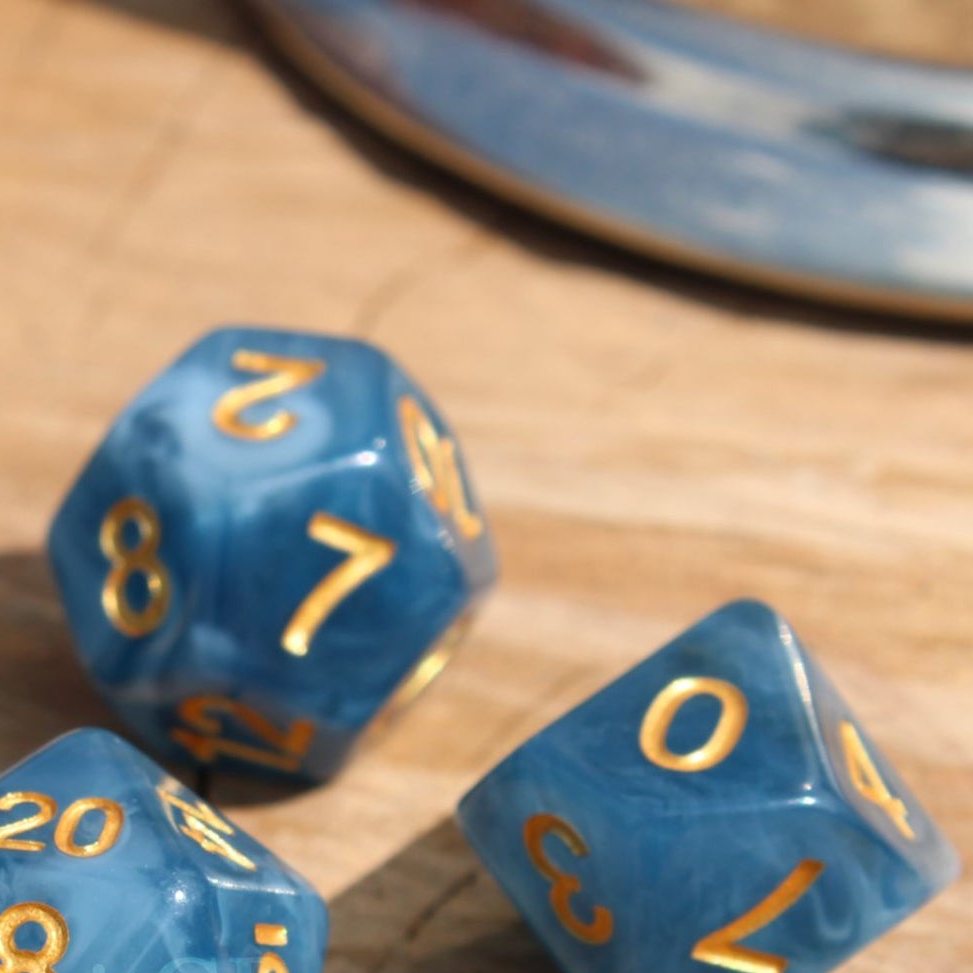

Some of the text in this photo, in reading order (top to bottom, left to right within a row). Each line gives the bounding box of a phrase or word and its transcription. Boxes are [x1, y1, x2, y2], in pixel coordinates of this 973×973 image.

[211, 349, 327, 442] 2
[98, 495, 173, 638] 8
[280, 510, 398, 656] 7
[170, 695, 315, 771] 12
[638, 676, 750, 773] 0
[839, 719, 916, 841] 4
[522, 812, 614, 946] 3
